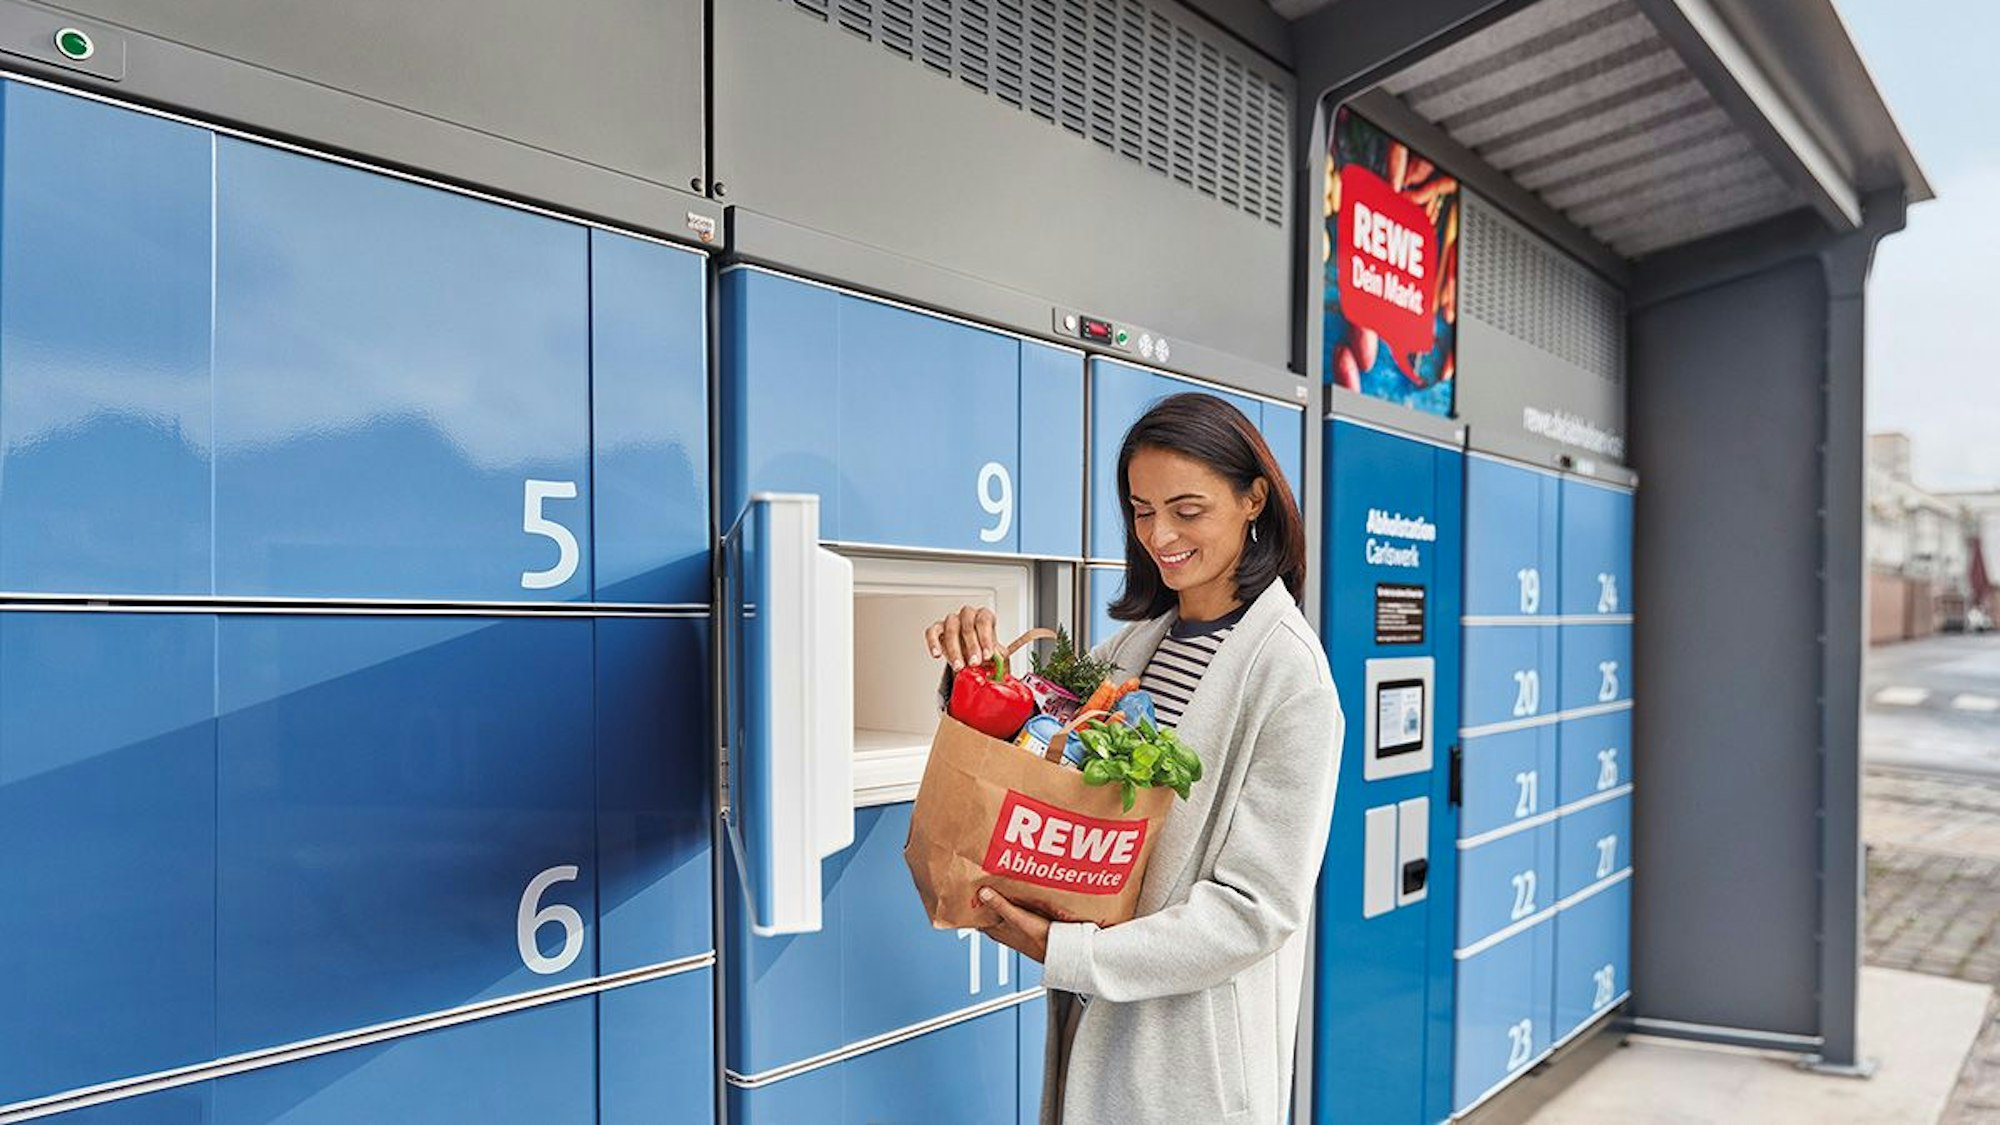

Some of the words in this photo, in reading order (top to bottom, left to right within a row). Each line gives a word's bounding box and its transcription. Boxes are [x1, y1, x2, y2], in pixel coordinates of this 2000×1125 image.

[1353, 201, 1424, 279] REWE
[1351, 255, 1383, 298] Dein
[977, 461, 1012, 542] 9
[521, 479, 579, 589] 5
[1518, 568, 1540, 614] 19
[1597, 572, 1618, 613] 24
[1513, 669, 1539, 716] 20
[1598, 661, 1618, 701] 25
[1597, 748, 1618, 791] 26
[1514, 770, 1537, 818] 21
[1004, 805, 1139, 865] REWE
[1596, 834, 1617, 880] 27
[997, 849, 1123, 886] Abholservice
[1511, 869, 1536, 921] 22
[517, 865, 584, 975] 6
[1593, 963, 1615, 1011] 28
[1507, 1018, 1532, 1072] 23
